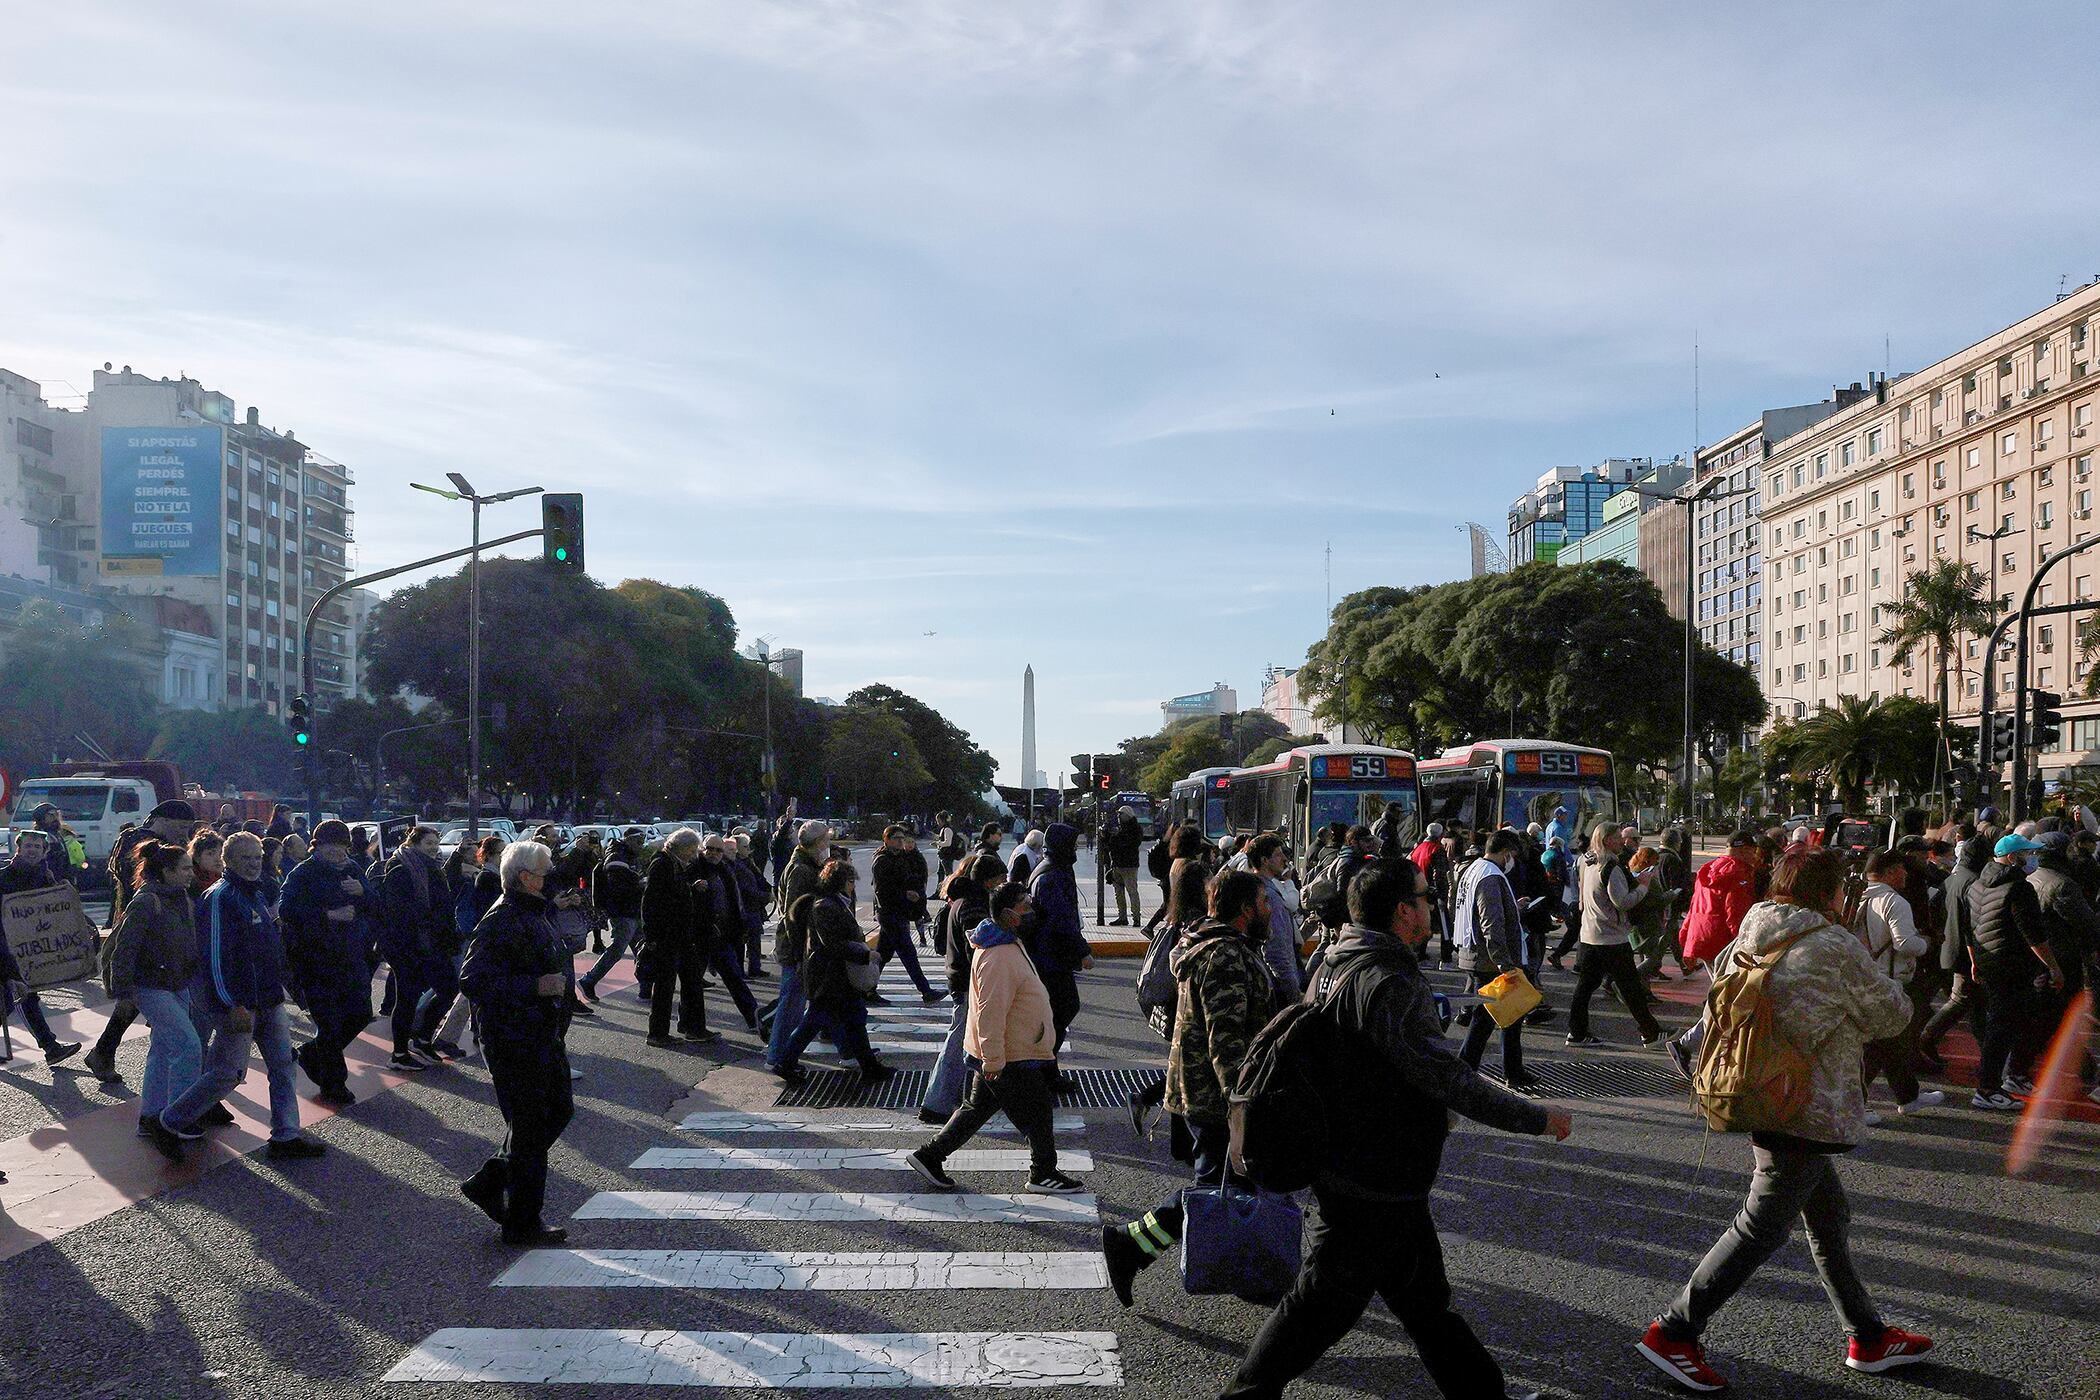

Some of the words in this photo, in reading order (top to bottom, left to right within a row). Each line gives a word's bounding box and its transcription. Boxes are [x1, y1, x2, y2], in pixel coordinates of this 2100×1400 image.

[127, 438, 139, 447] SI
[141, 435, 198, 447] APOSTÁS
[140, 455, 184, 466] ILEGAL,
[138, 467, 185, 478] PERDÉS
[135, 487, 190, 496] SIEMPRE.
[136, 502, 154, 511] NO
[157, 502, 171, 511] TE
[173, 502, 189, 511] LA
[135, 524, 190, 533] JUEGUES.
[1352, 757, 1385, 777] 59
[1542, 753, 1576, 772] 59
[1101, 775, 1110, 789] 2
[35, 918, 52, 933] de
